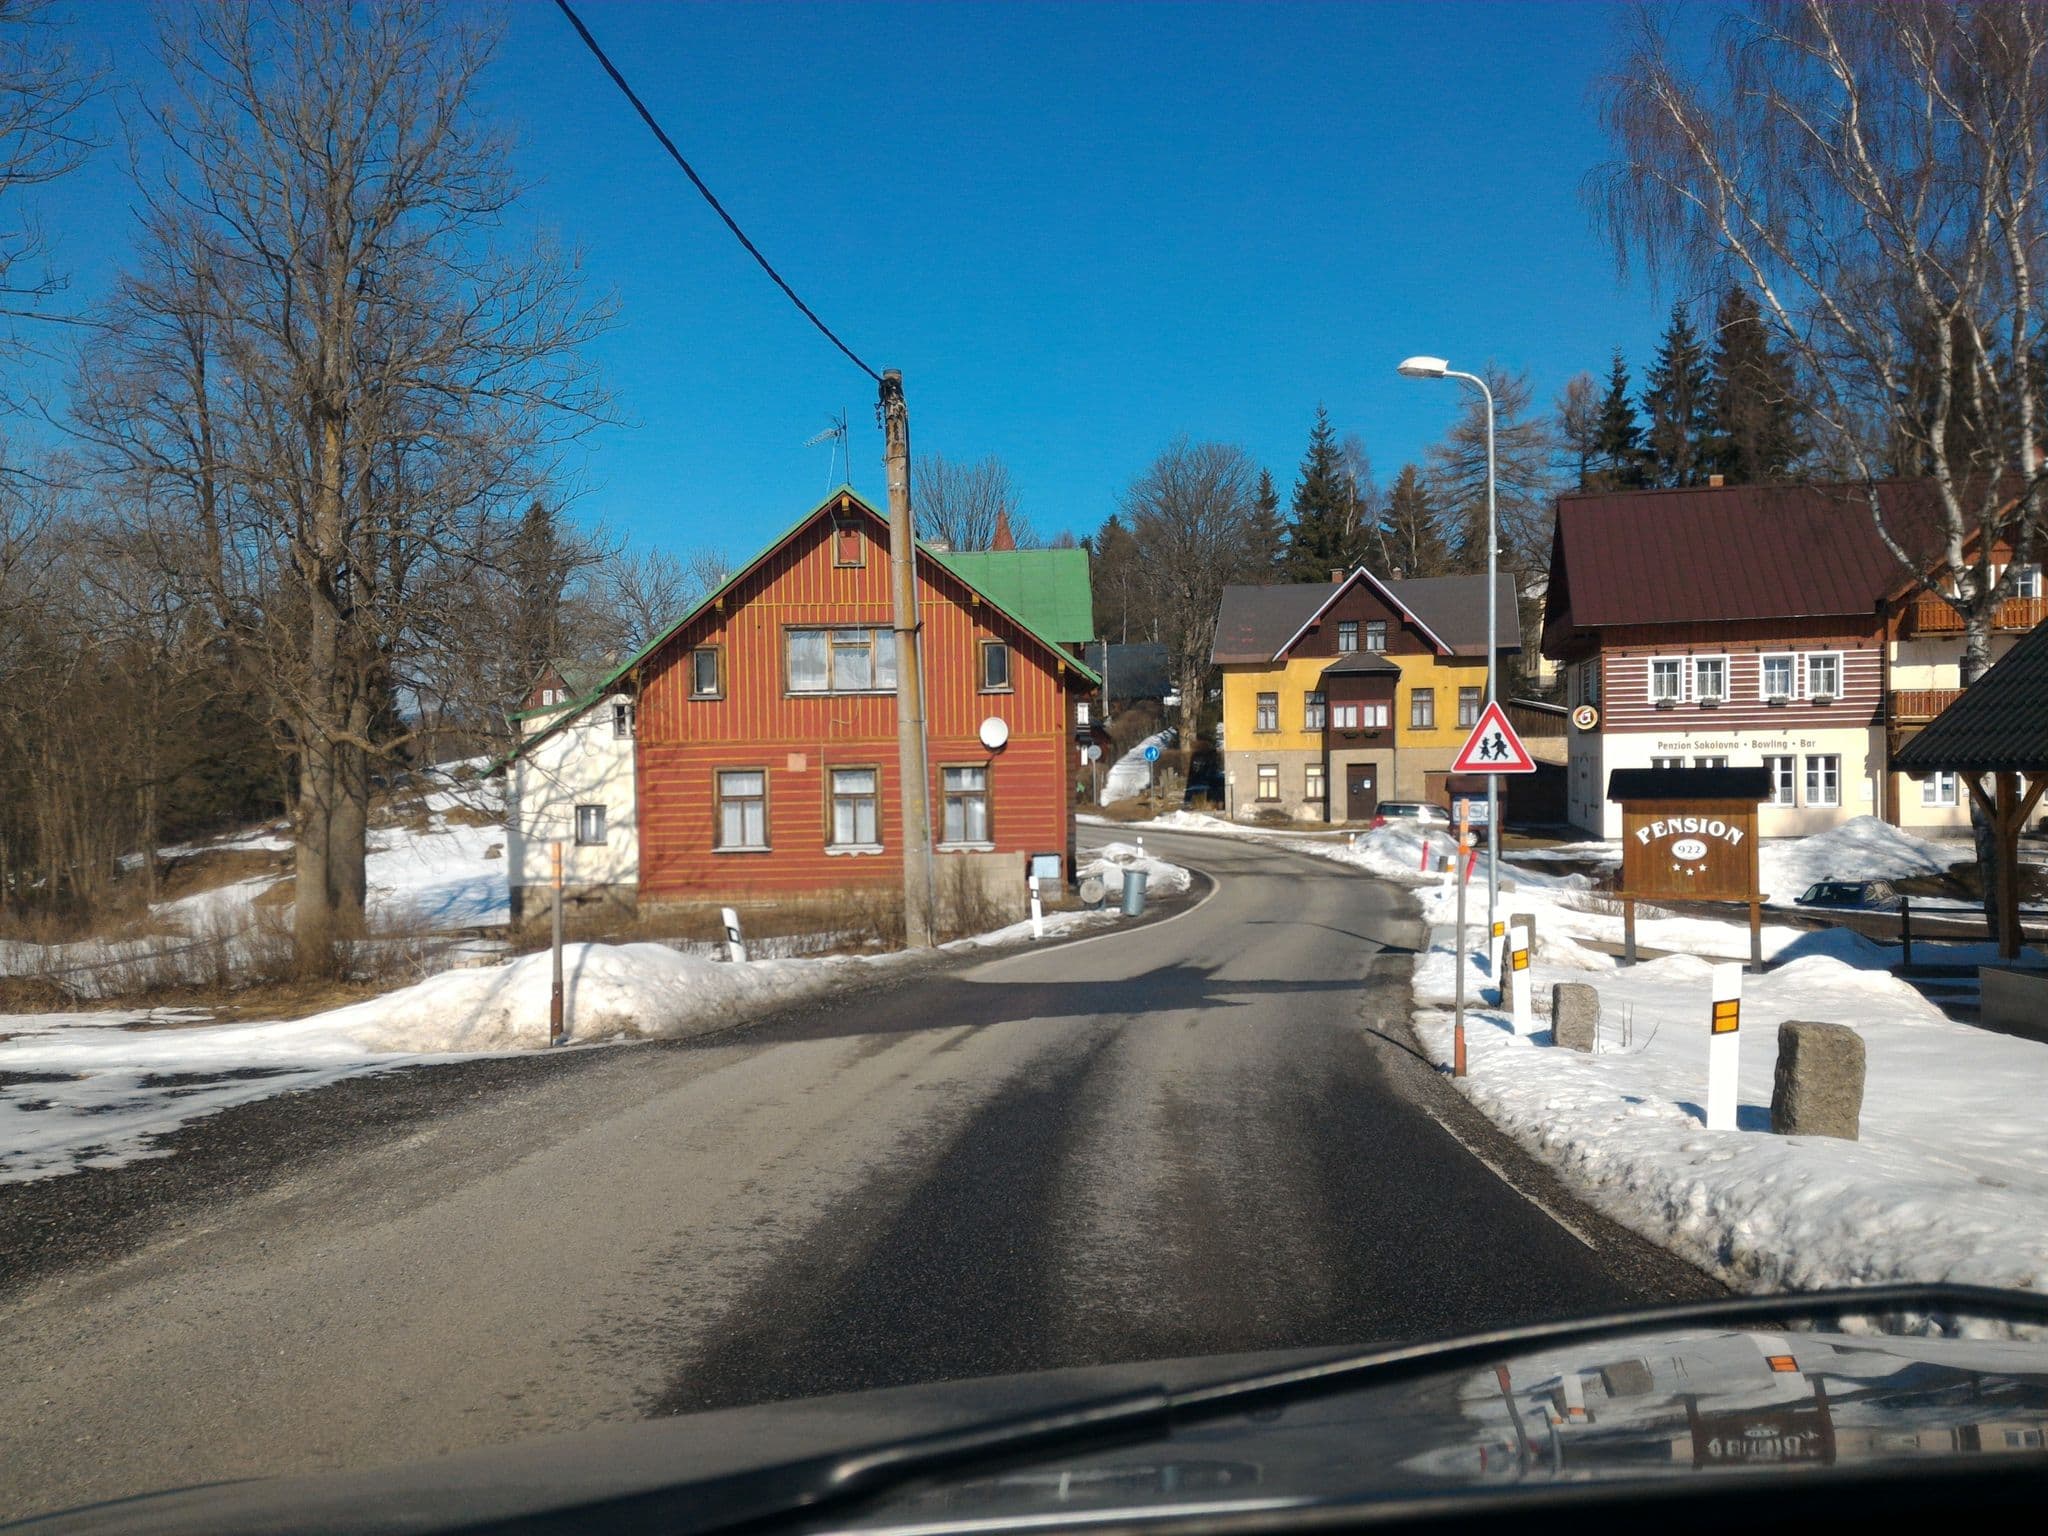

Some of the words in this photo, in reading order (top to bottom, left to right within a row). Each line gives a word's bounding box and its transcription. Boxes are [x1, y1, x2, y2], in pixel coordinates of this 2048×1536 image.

[1657, 741, 1692, 750] Penzion
[1751, 739, 1788, 751] Bowling
[1800, 739, 1816, 748] Bar
[1636, 817, 1744, 846] PENSION
[1677, 844, 1702, 855] 922
